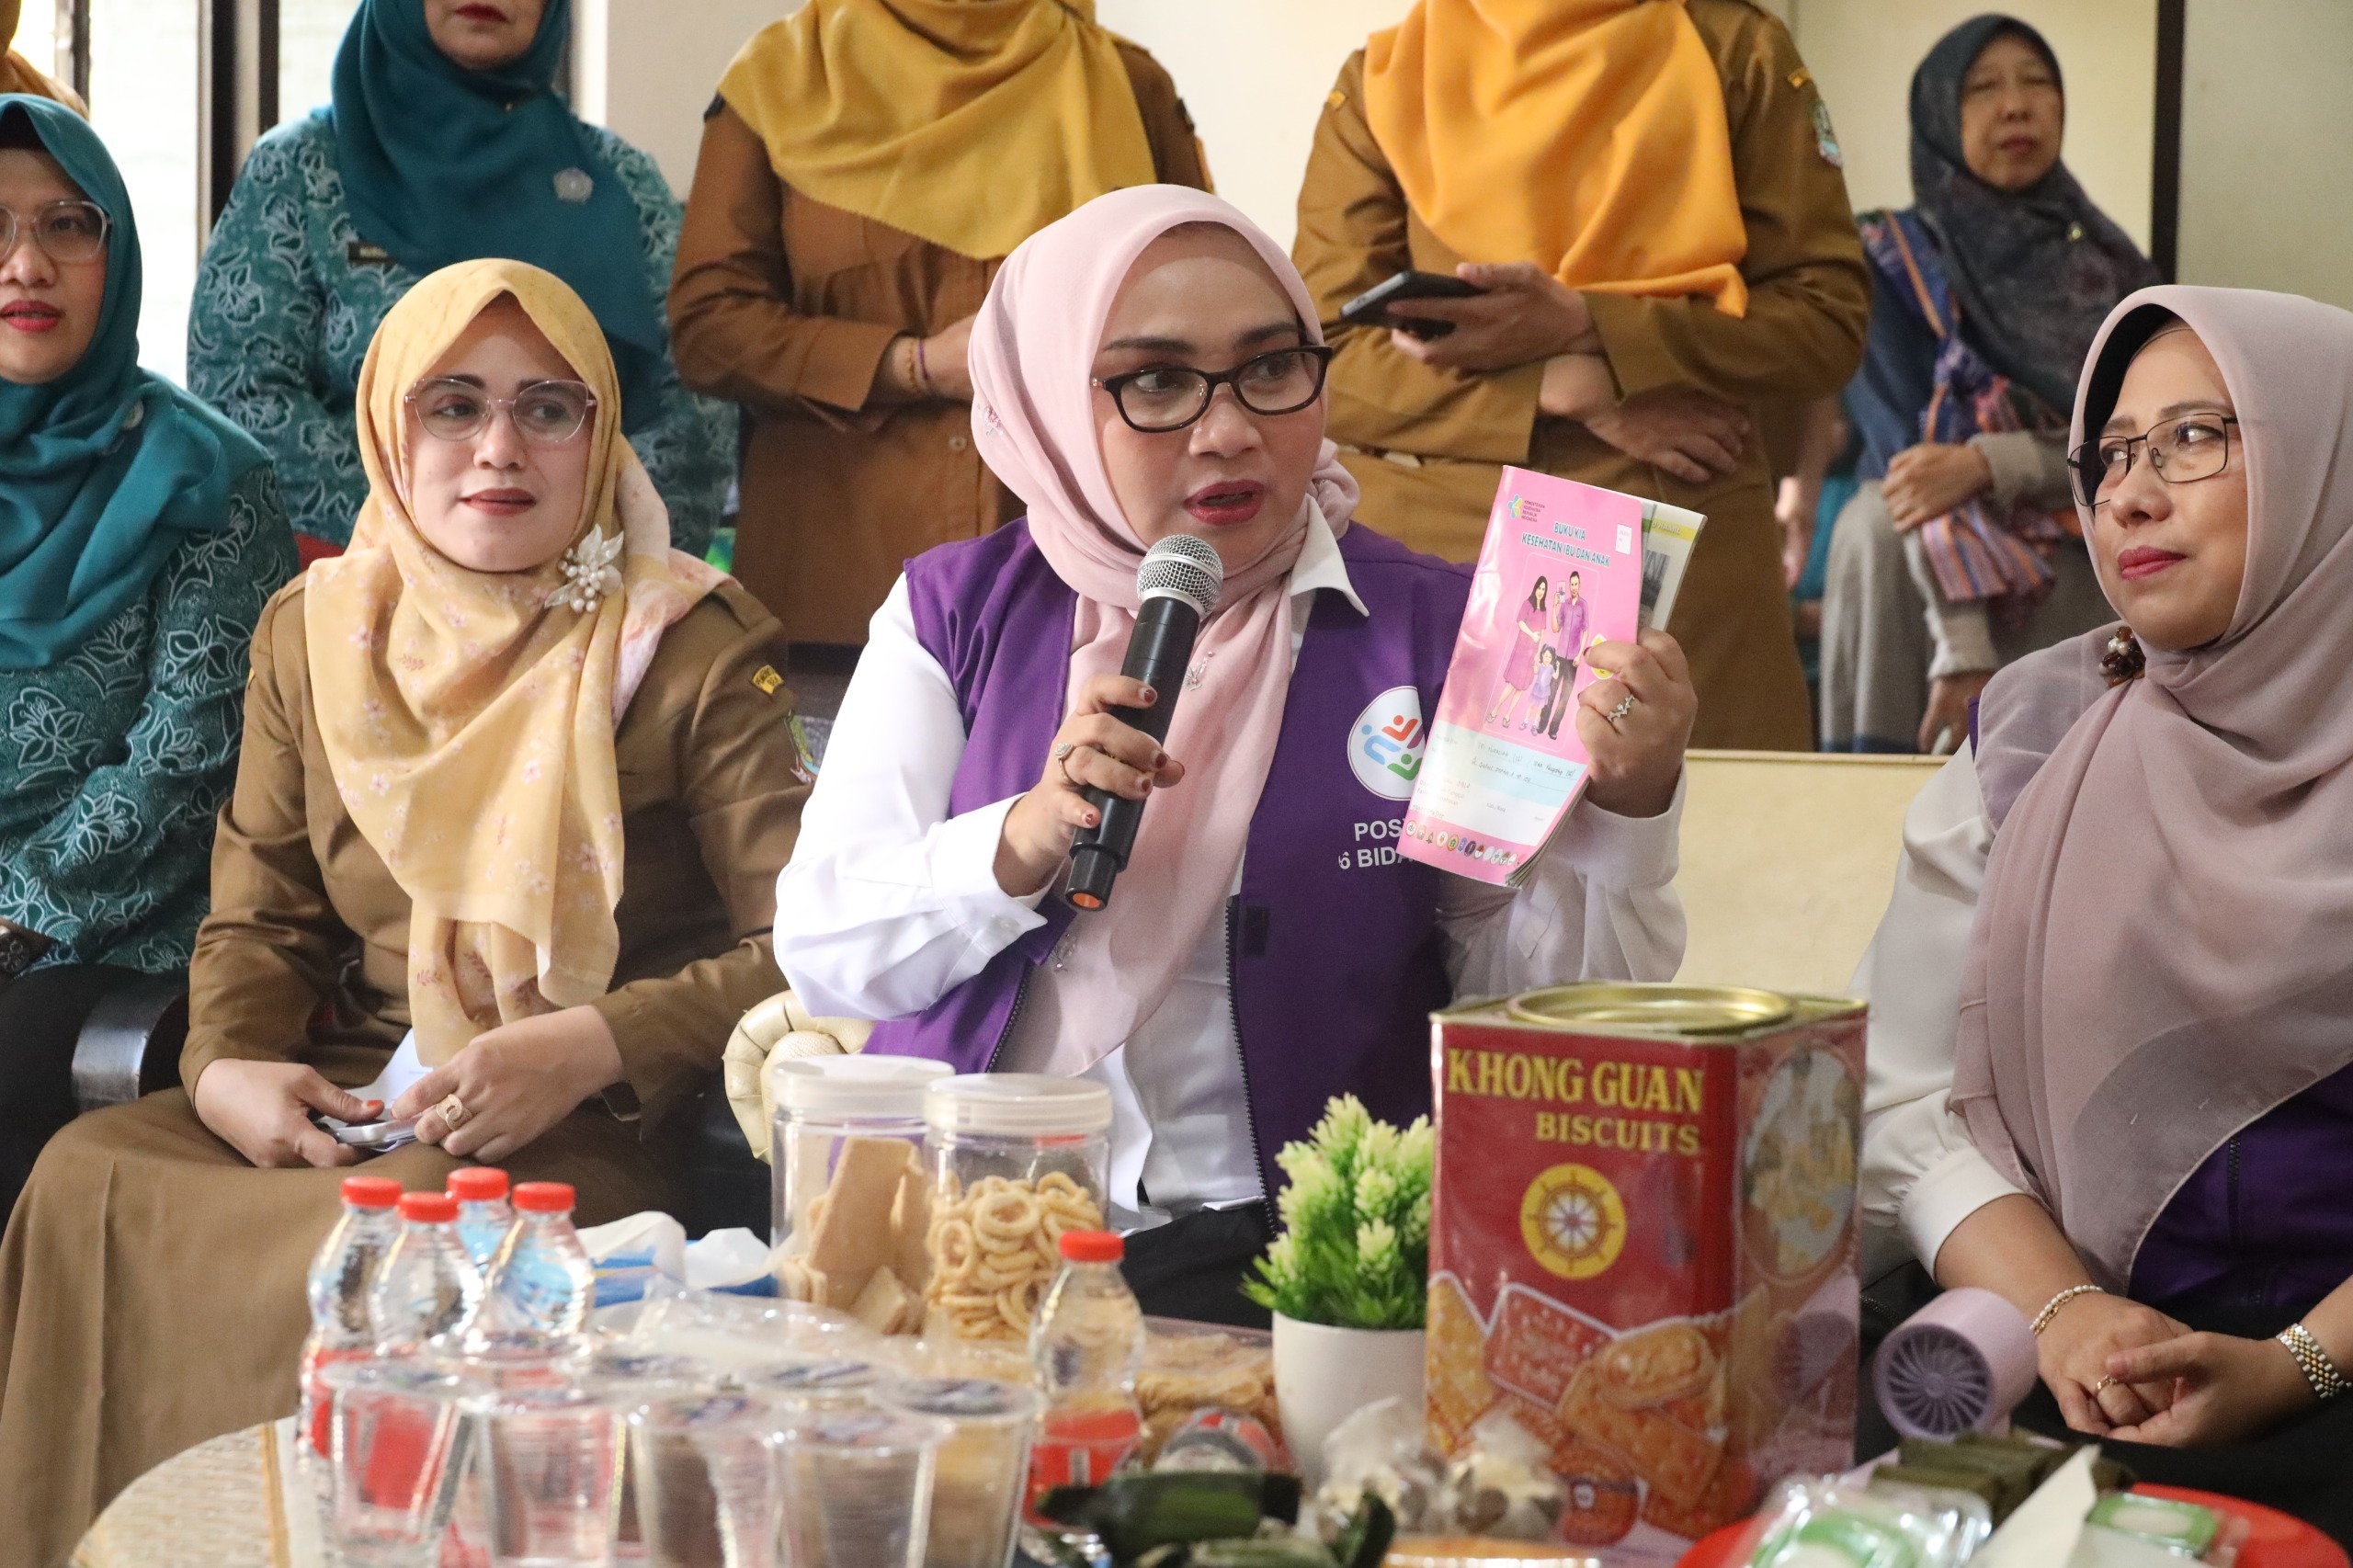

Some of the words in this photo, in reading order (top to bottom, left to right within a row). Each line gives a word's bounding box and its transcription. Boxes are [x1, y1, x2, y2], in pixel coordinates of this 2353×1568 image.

[1553, 521, 1574, 538] BUKU
[1574, 527, 1586, 541] KIA
[1521, 532, 1563, 553] KESEHATAN
[1563, 544, 1575, 557] IBU
[1575, 547, 1591, 562] DAN
[1590, 552, 1610, 567] ANAK
[1354, 818, 1404, 841] POS
[1447, 1048, 1585, 1104] KHONG
[1591, 1061, 1704, 1114] GUAN
[1535, 1111, 1700, 1156] BISCUITS
